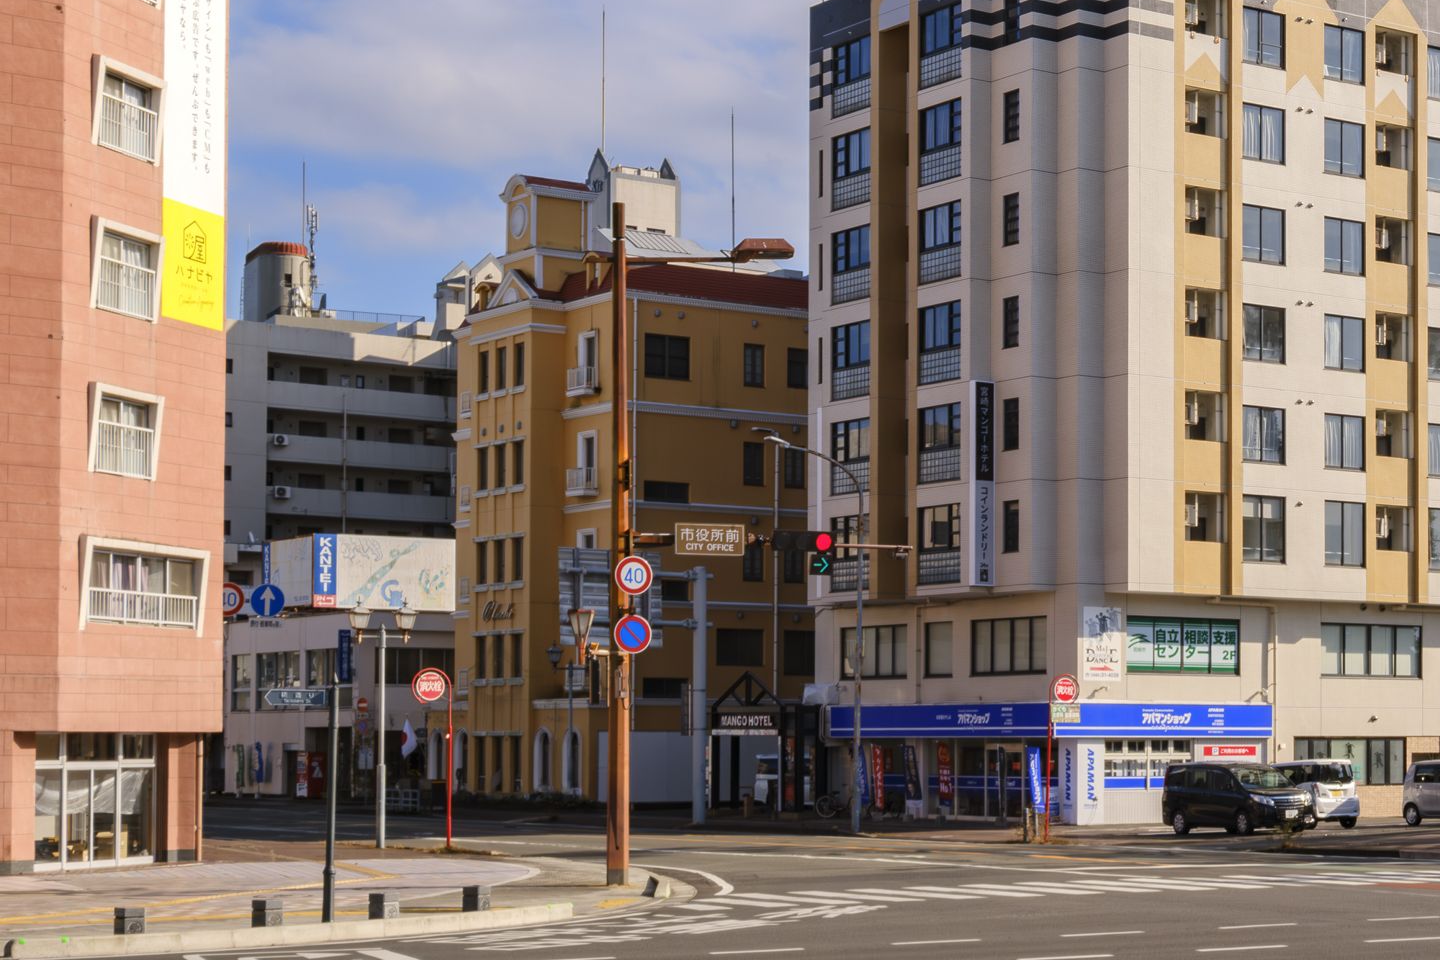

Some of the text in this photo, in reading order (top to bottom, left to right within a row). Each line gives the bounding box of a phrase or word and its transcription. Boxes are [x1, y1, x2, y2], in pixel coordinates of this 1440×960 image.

[176, 265, 213, 284] ハナビヤ
[979, 486, 989, 560] コインランドリー
[680, 528, 739, 543] 市役所前
[686, 543, 735, 552] CITY OFFICE
[320, 537, 332, 593] KANTEI
[624, 567, 644, 584] 40
[1154, 644, 1236, 661] センター 2F
[721, 715, 772, 727] MANGO HOTEL
[957, 713, 990, 724] アパマンショップ
[1142, 712, 1191, 724] アパマンショップ
[1087, 748, 1095, 800] APAMAN
